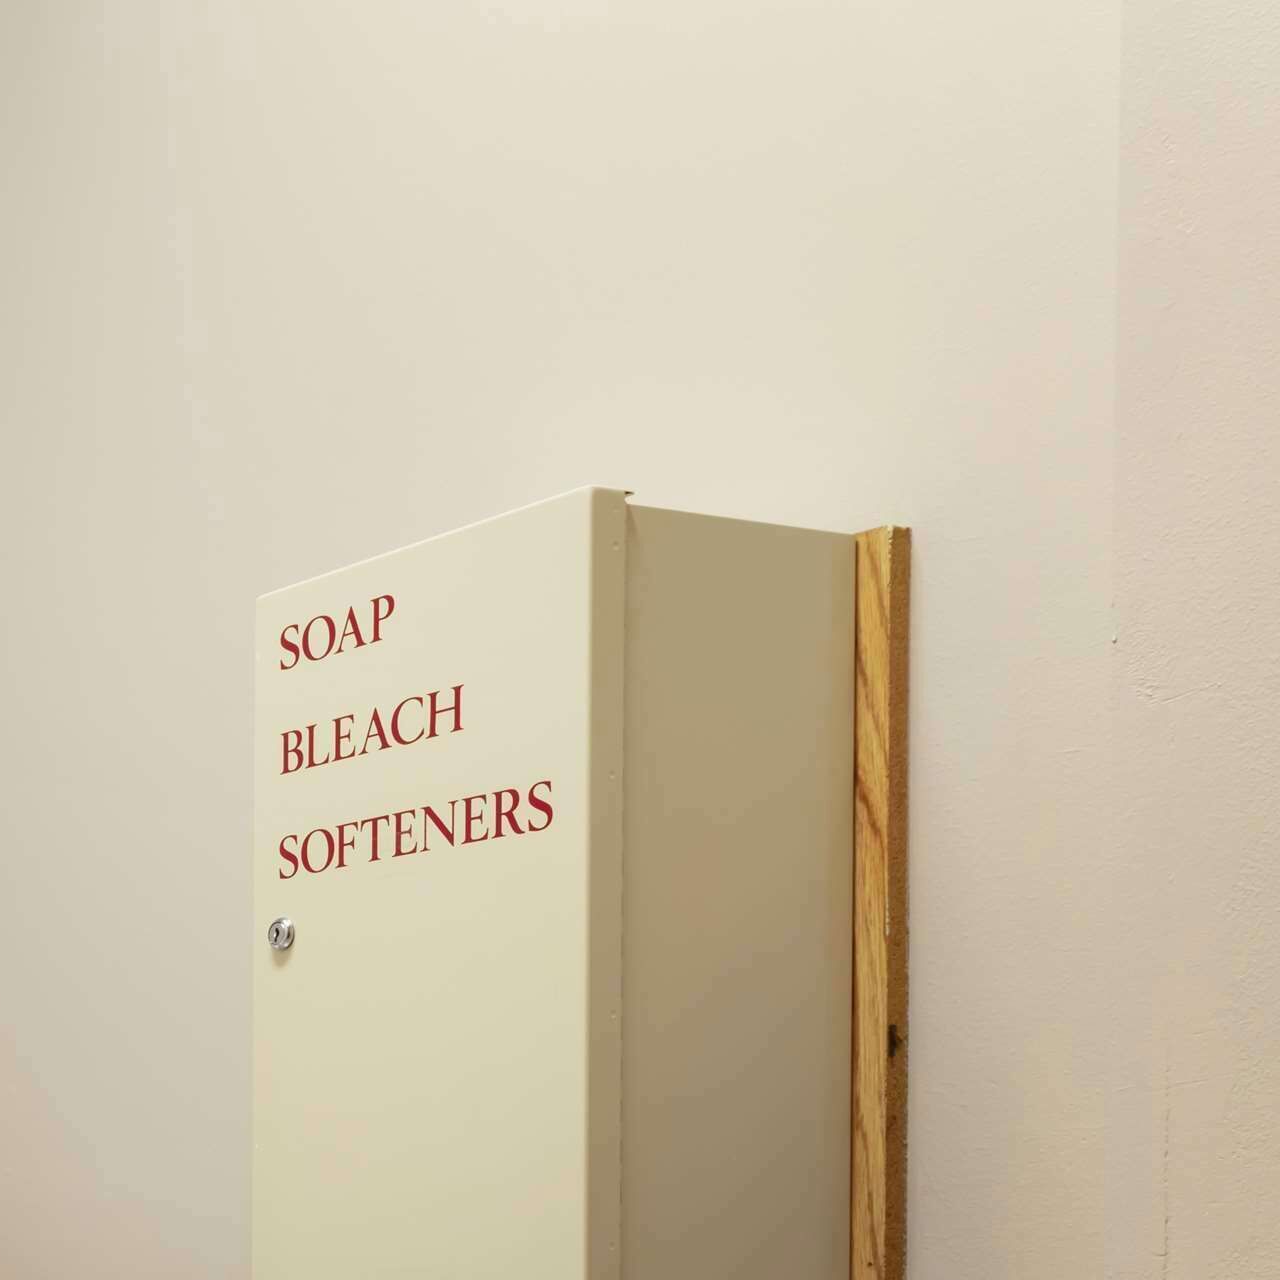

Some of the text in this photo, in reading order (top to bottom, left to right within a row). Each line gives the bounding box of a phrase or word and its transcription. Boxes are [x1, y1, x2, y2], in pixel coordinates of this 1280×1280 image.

[279, 594, 396, 671] SOAP
[279, 684, 465, 776] BLEACH
[278, 780, 554, 880] SOFTENERS
